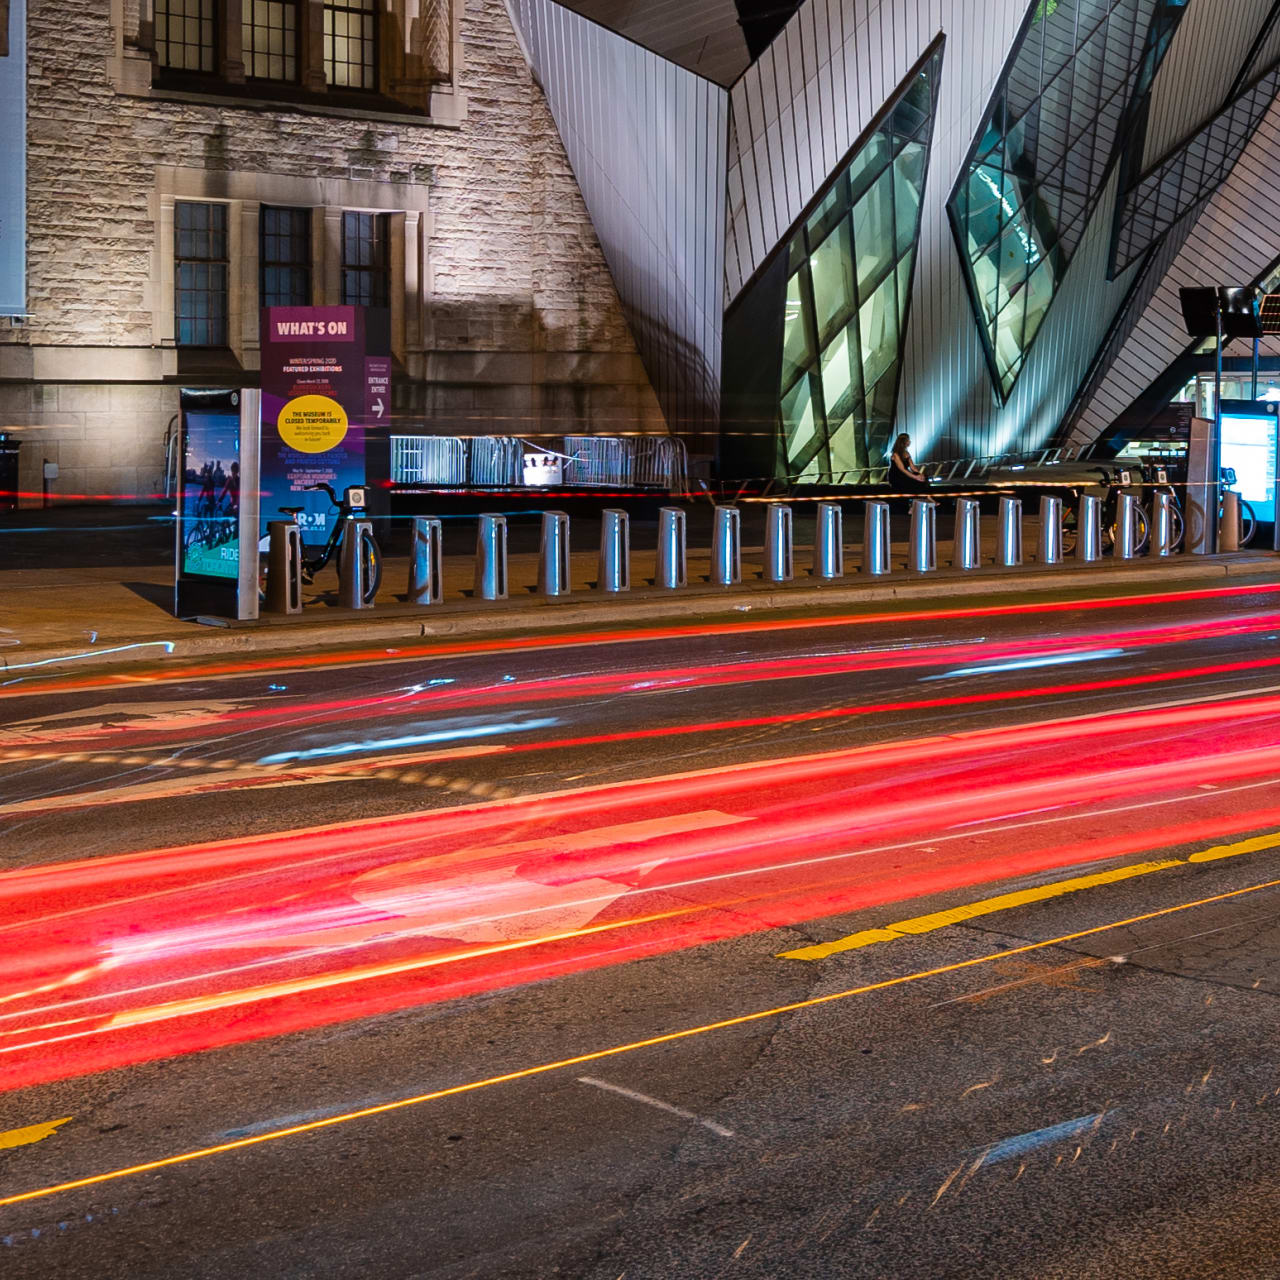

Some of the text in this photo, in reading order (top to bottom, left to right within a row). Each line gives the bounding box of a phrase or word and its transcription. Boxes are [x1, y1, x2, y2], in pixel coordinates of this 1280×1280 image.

[277, 321, 347, 336] WHAT'S ON
[368, 376, 389, 384] ENTRANCE
[221, 548, 239, 560] RIDE
